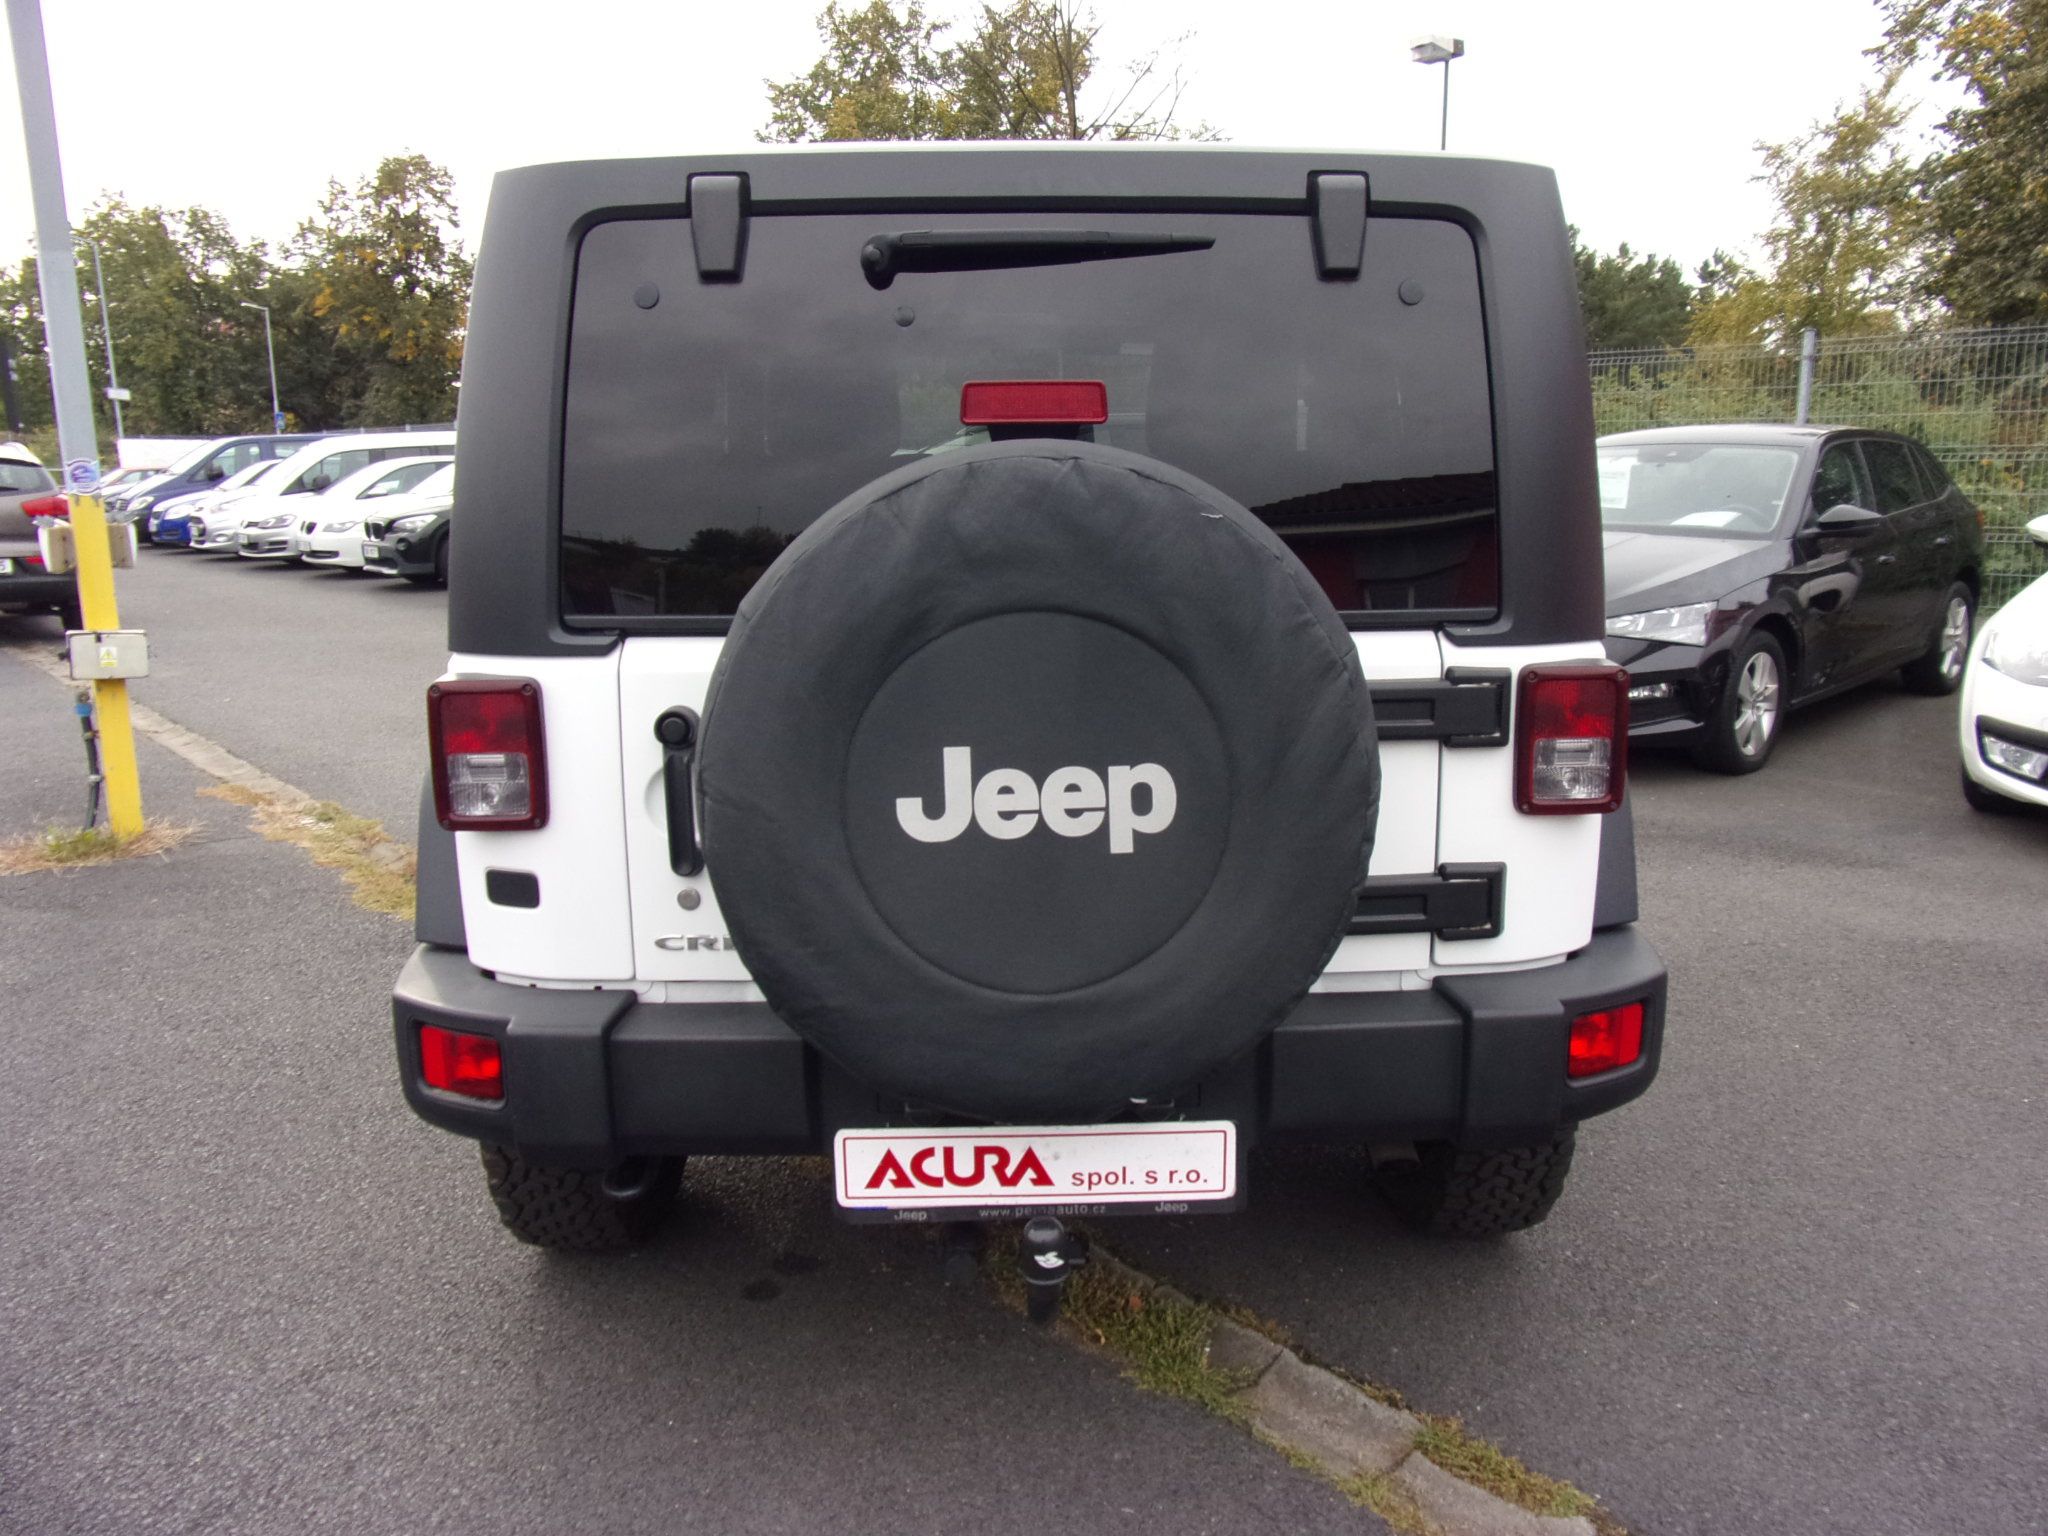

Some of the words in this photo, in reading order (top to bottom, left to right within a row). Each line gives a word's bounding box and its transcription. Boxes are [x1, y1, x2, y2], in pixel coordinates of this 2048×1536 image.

[895, 746, 1178, 854] Jeep
[864, 1145, 1055, 1190] ACURA
[1070, 1165, 1135, 1191] spol.
[1144, 1169, 1158, 1185] s
[1168, 1168, 1208, 1184] r.o.
[894, 1209, 928, 1222] Jeep
[1154, 1200, 1188, 1214] Jeep
